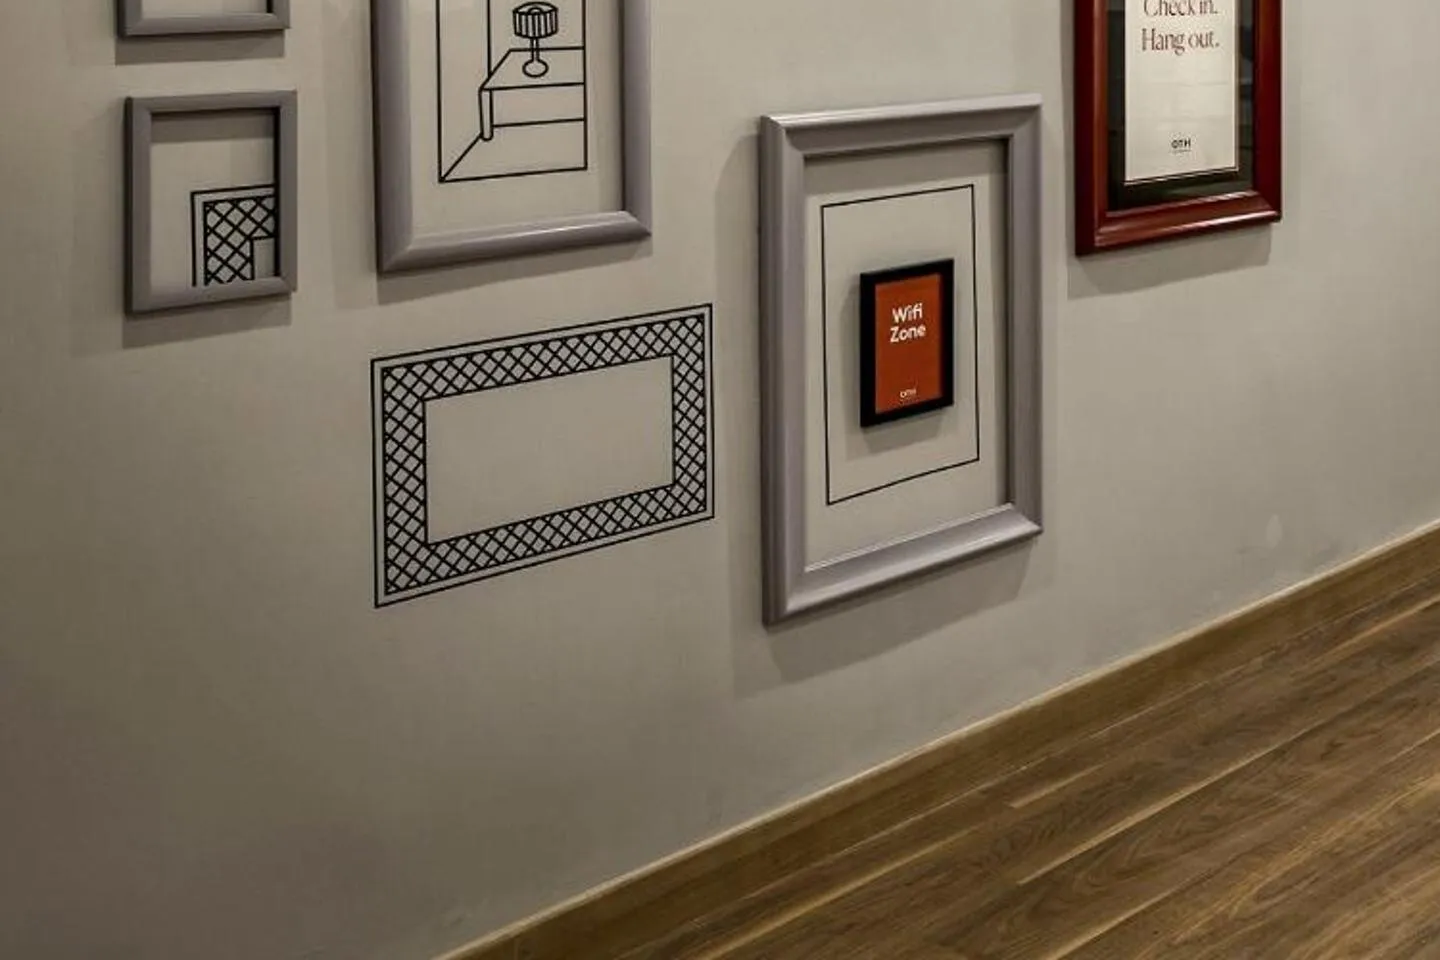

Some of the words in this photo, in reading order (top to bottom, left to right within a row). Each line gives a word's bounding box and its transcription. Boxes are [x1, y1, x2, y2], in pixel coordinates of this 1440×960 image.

[1141, 27, 1186, 56] Hang
[1188, 30, 1220, 49] out.
[892, 302, 923, 324] Wifi
[890, 324, 927, 343] Zone
